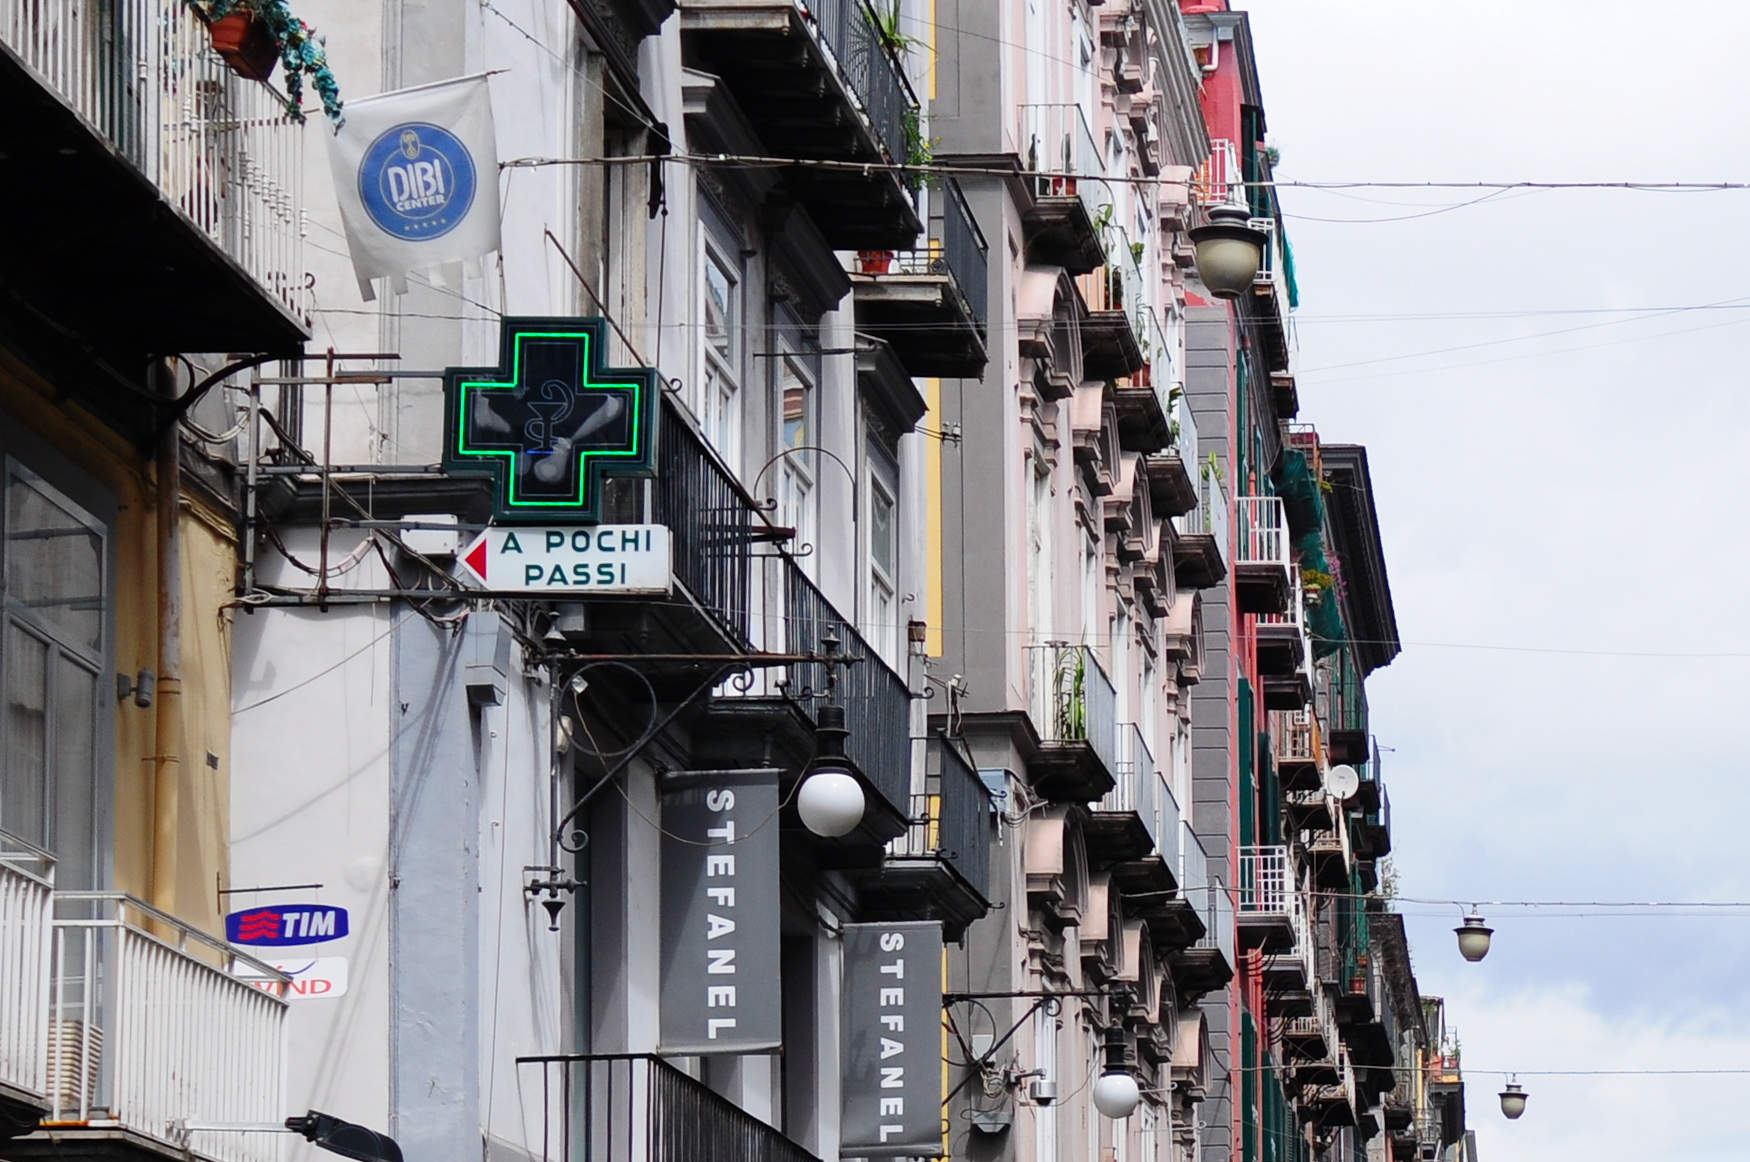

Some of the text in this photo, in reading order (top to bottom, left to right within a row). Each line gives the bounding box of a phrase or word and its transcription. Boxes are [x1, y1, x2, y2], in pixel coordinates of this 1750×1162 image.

[387, 158, 445, 203] DIBI
[396, 194, 447, 211] CENTER
[500, 529, 651, 554] A POCHI
[524, 562, 626, 586] PASSI
[282, 910, 336, 938] TIM
[706, 788, 737, 1039] STEFANEL
[879, 932, 904, 1142] STEFANEL
